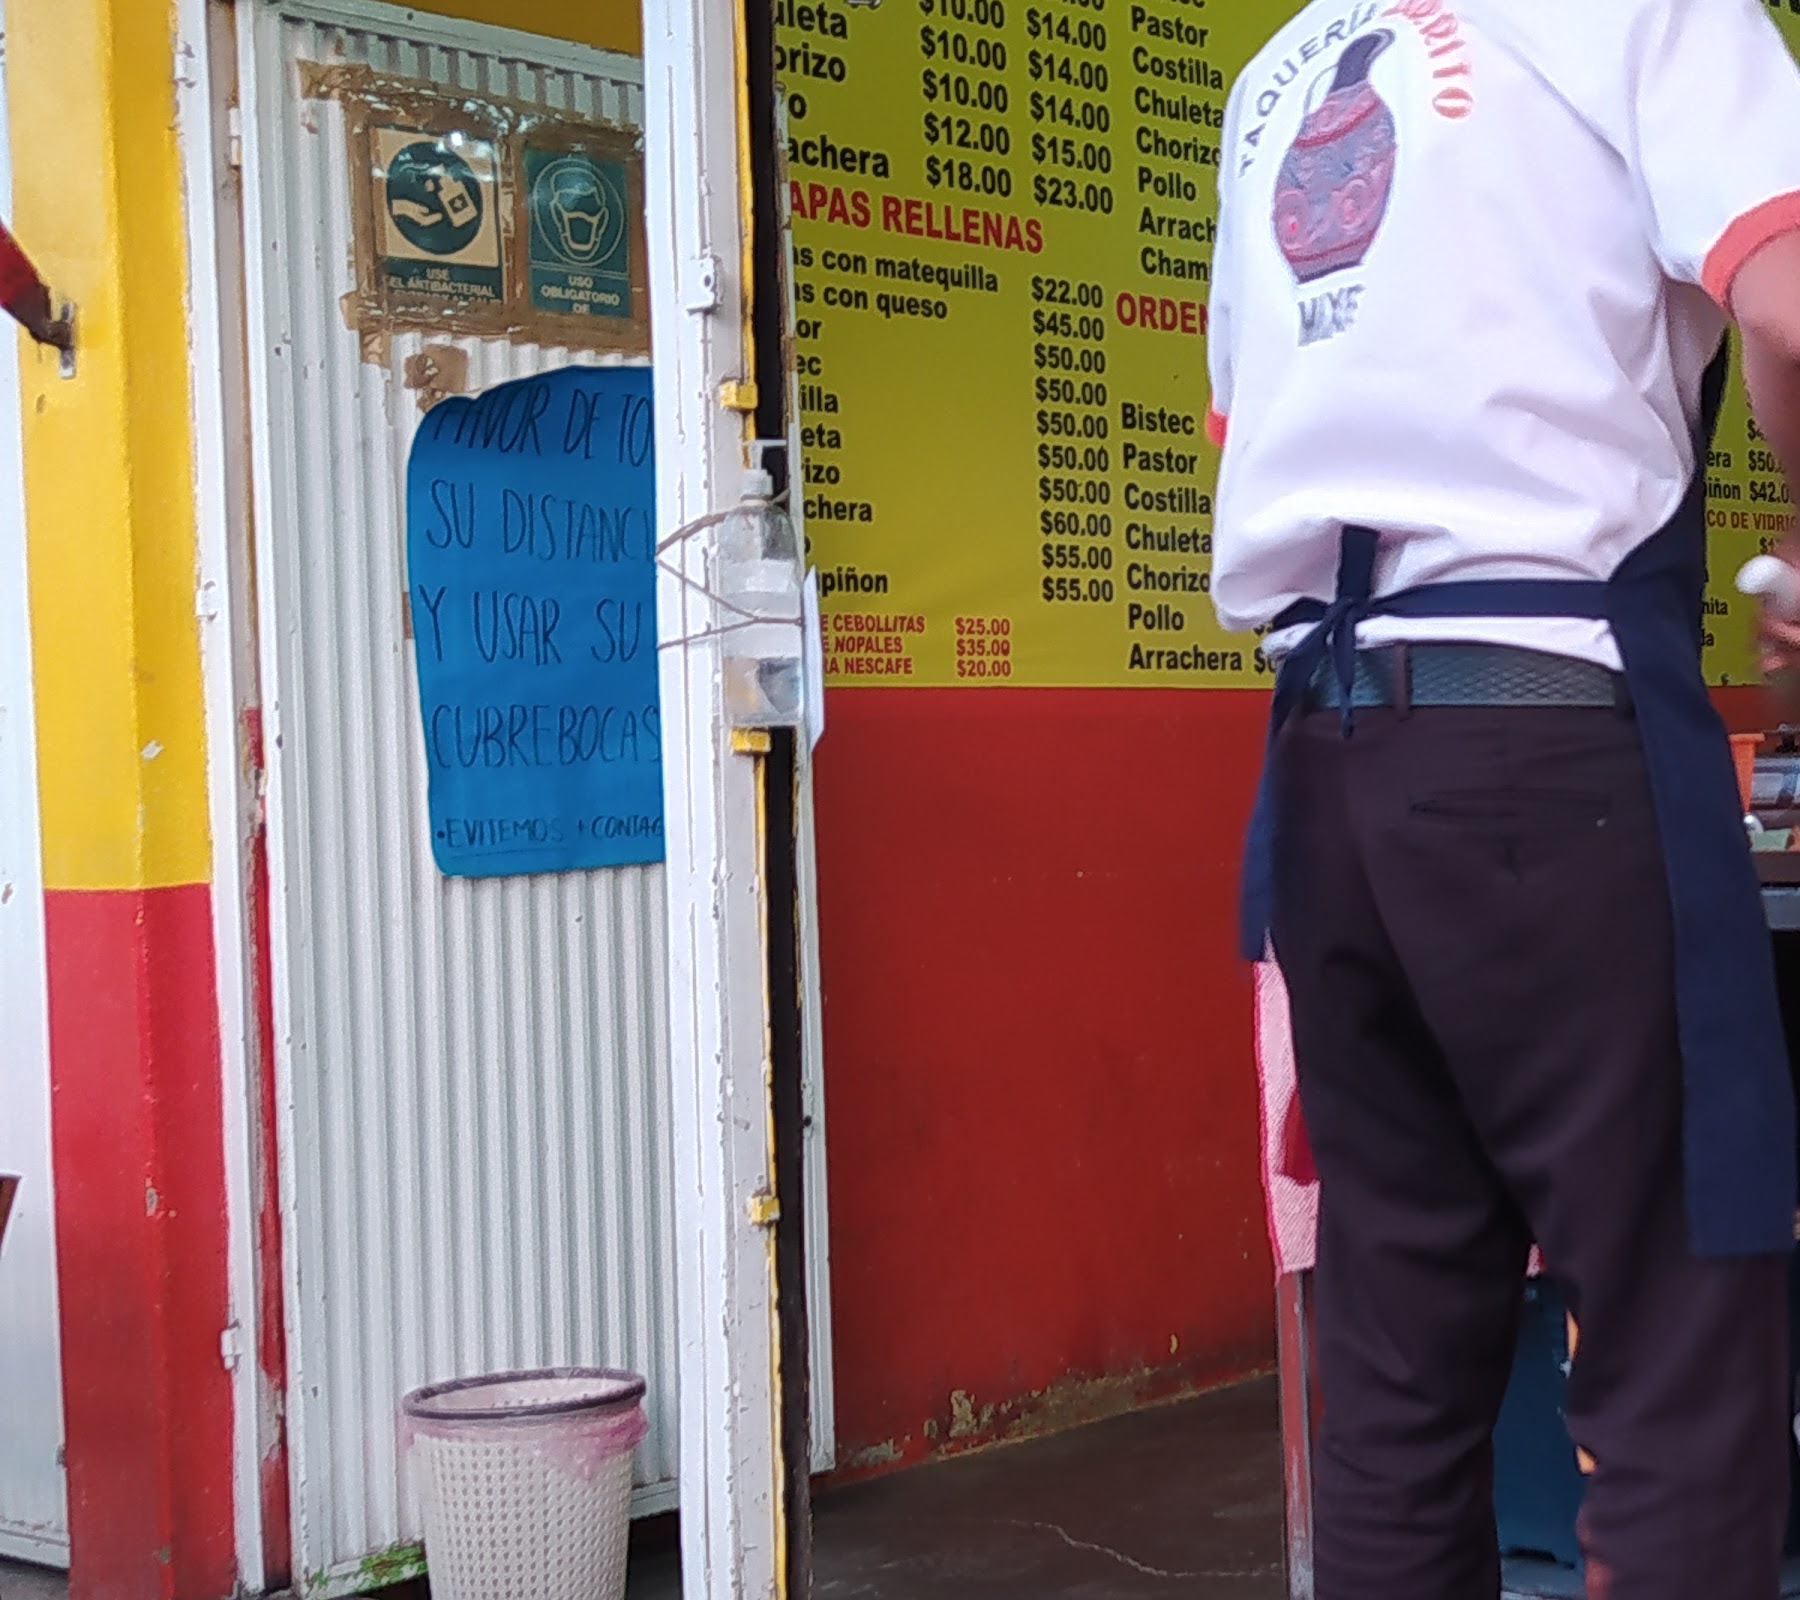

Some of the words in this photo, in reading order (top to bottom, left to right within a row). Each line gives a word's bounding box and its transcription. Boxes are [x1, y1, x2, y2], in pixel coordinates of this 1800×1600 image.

[1026, 7, 1106, 51] $14.00
[1131, 4, 1208, 48] Pastor
[920, 25, 1007, 71] $10.00
[1028, 49, 1108, 93] $14.00
[1132, 46, 1223, 90] Costilla
[922, 68, 1008, 113] $10.00
[1029, 90, 1110, 133] $14.00
[924, 112, 1010, 155] $12.00
[1032, 132, 1111, 173] $15.00
[926, 155, 1011, 197] $18.00
[1138, 166, 1197, 202] Pollo
[1034, 174, 1113, 214] $23.00
[882, 195, 1043, 254] RELLENAS
[822, 250, 867, 275] con
[875, 257, 998, 292] matequilla
[540, 284, 621, 306] OBLIGATORIO
[823, 287, 868, 310] con
[877, 292, 948, 319] queso
[1031, 275, 1104, 308] $22.00
[1033, 309, 1105, 341] $45.00
[1034, 342, 1106, 374] $50.00
[1035, 376, 1107, 407] $50.00
[1036, 409, 1109, 440] $50.00
[1121, 402, 1195, 435] Bistec
[1038, 443, 1110, 472] $50.00
[1123, 442, 1197, 475] Pastor
[1039, 476, 1111, 505] $50.00
[1124, 482, 1212, 514] Costilla
[426, 478, 476, 549] SU
[1040, 509, 1112, 537] $60.00
[1126, 523, 1213, 554] Chuleta
[1042, 543, 1112, 570] $55.00
[1042, 576, 1113, 602] $55.00
[418, 584, 447, 662] Y
[473, 590, 562, 667] USAR
[590, 596, 645, 665] SU
[833, 614, 925, 633] CEBOLLITAS
[955, 617, 1010, 636] $25.00
[1128, 603, 1184, 631] Pollo
[834, 636, 903, 653] NOPALES
[956, 639, 1011, 657] $35.00
[1128, 643, 1243, 671] Arrachera
[844, 657, 913, 675] NESCAFE
[957, 660, 1012, 678] $20.00
